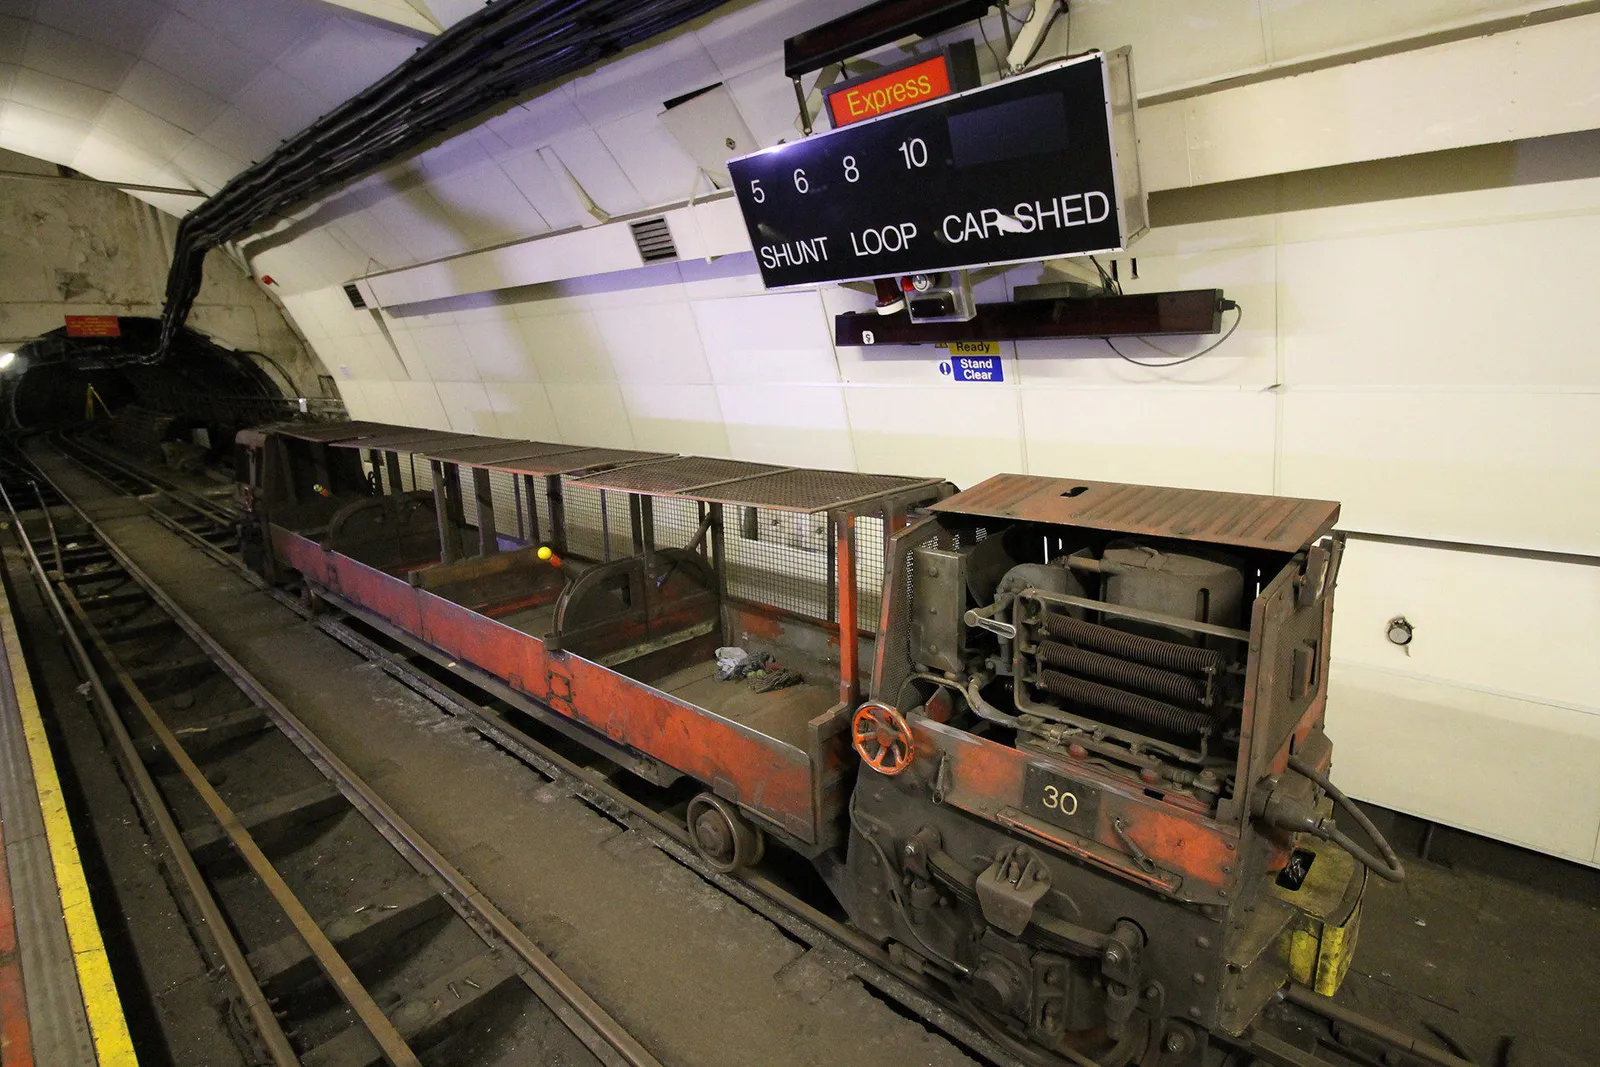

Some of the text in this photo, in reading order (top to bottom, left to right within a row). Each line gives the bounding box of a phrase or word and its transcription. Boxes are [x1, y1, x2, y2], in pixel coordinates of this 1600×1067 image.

[846, 74, 932, 117] Express
[750, 137, 928, 204] 5 6 8 10
[760, 190, 1110, 269] SHUNT LOOP CAR SHED
[956, 341, 991, 353] Ready
[960, 358, 993, 369] Stand
[963, 369, 993, 380] Clear
[1042, 785, 1078, 816] 30
